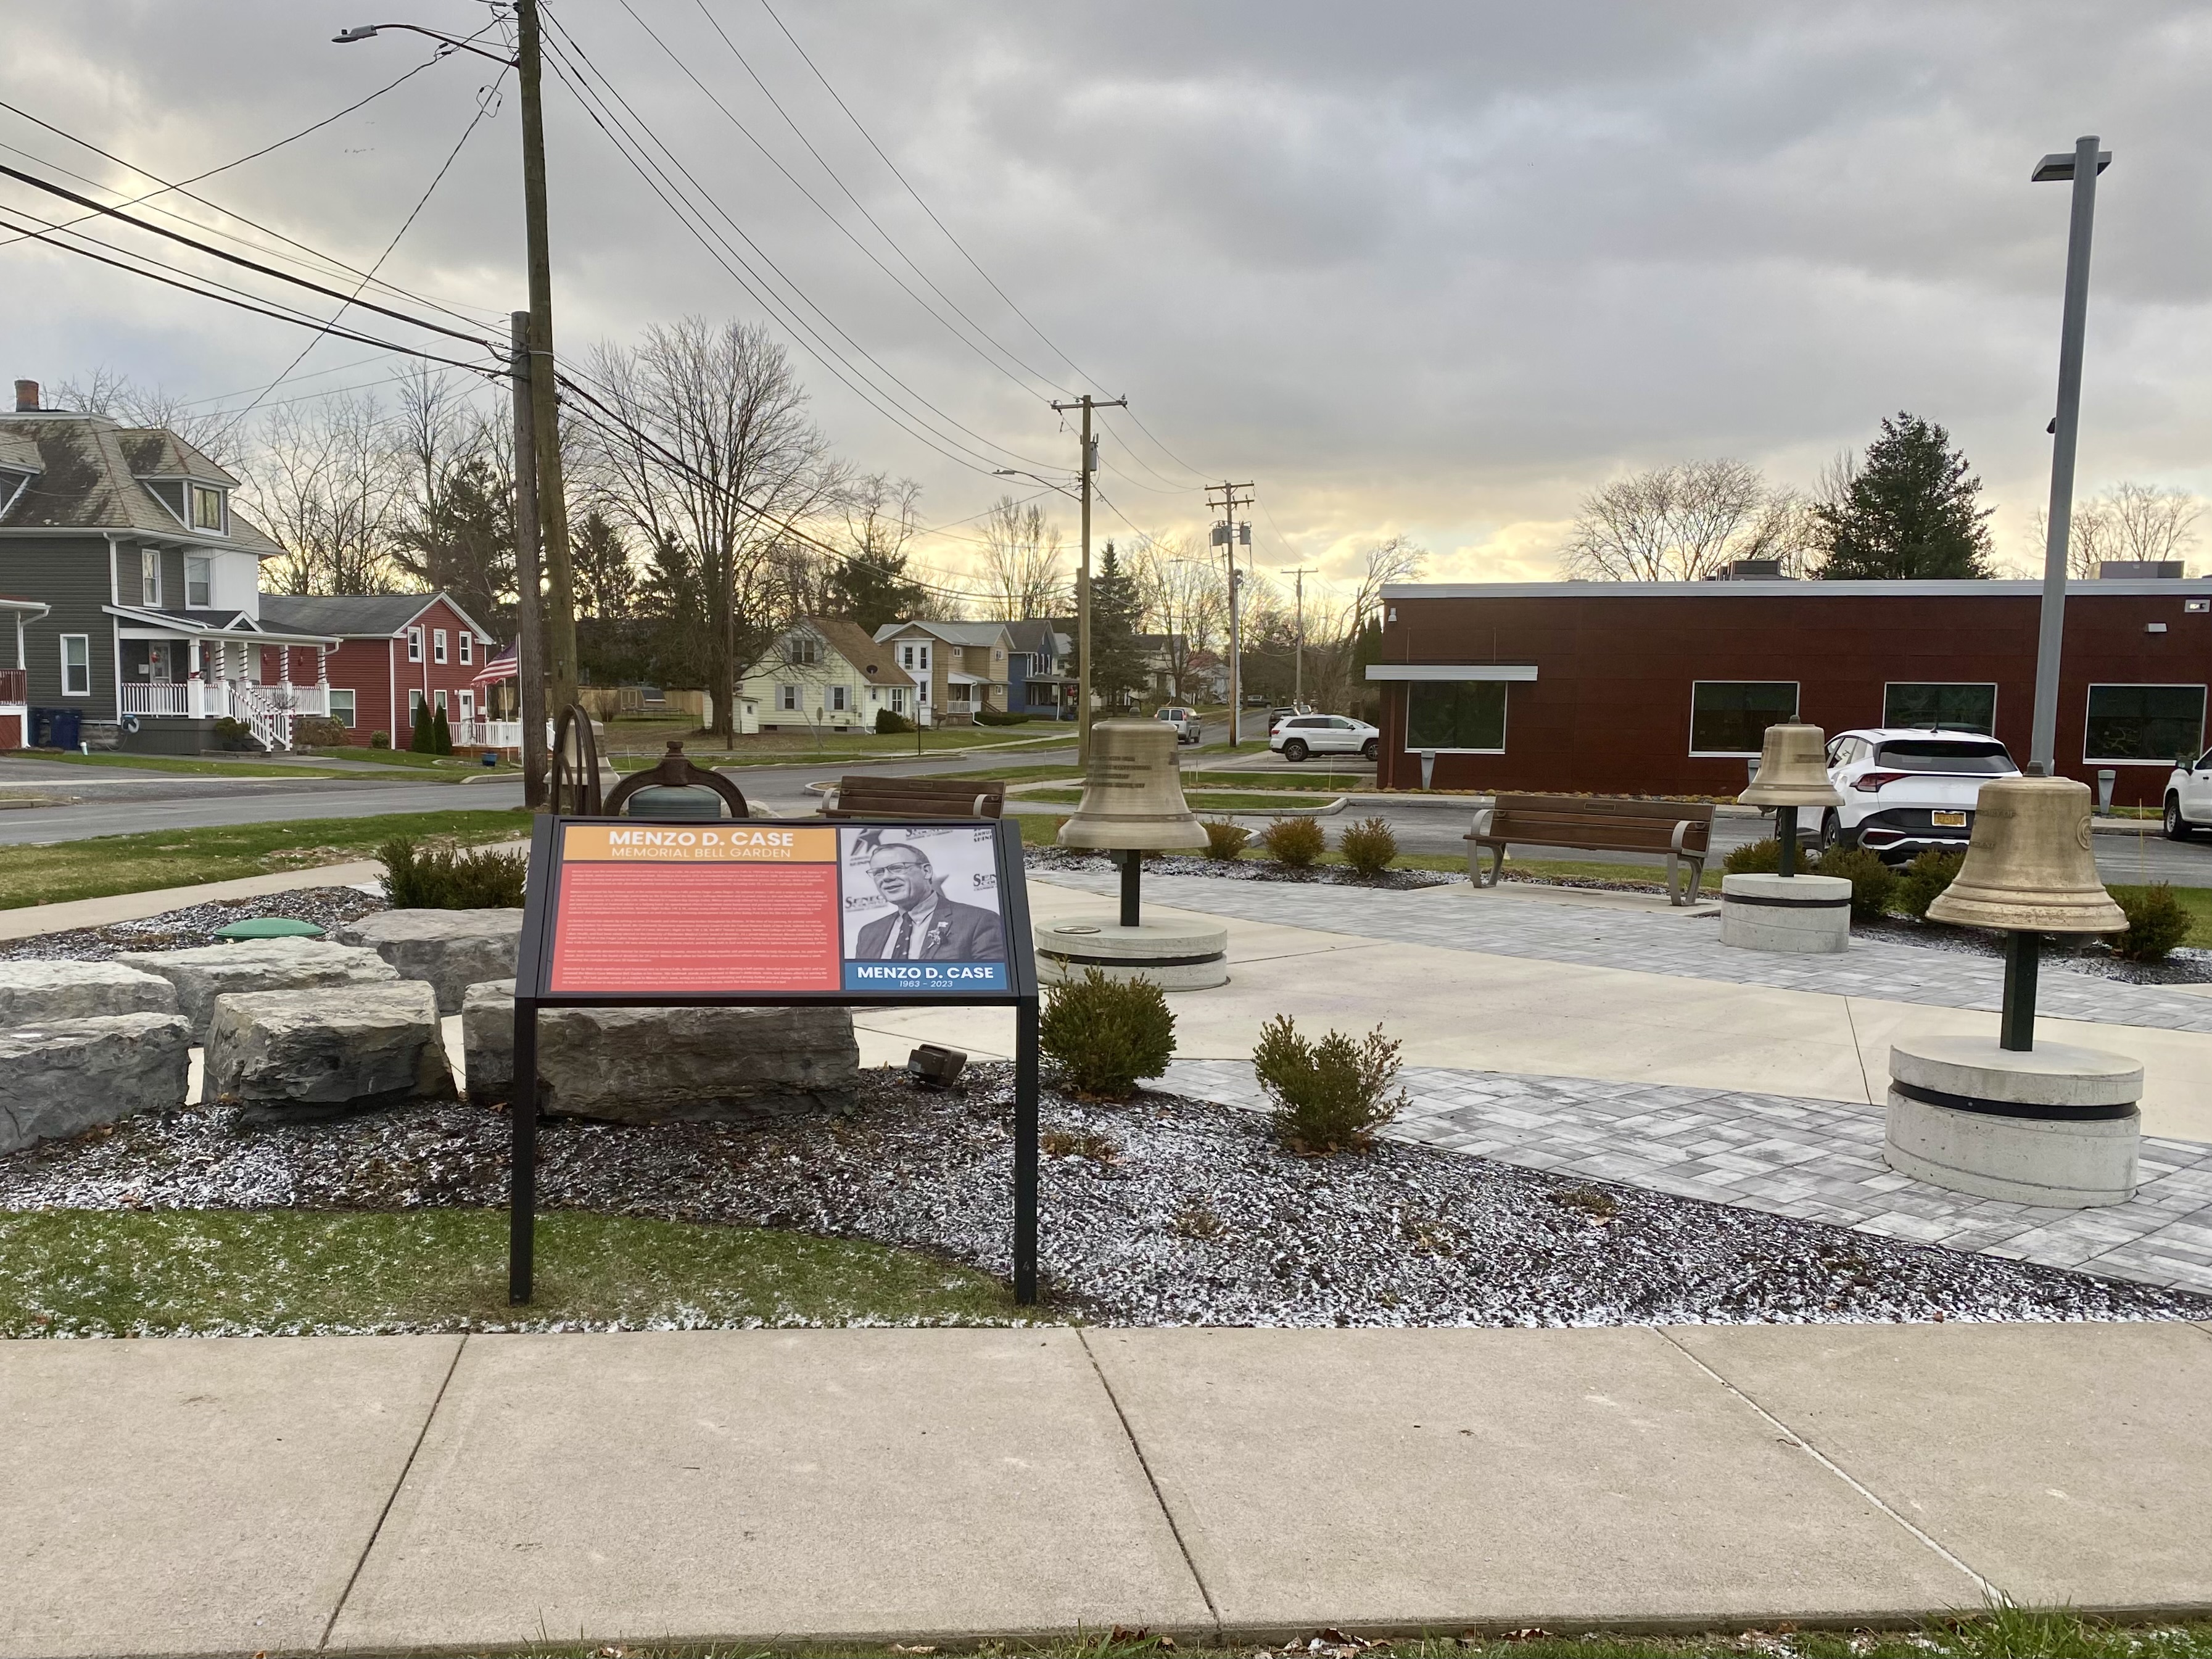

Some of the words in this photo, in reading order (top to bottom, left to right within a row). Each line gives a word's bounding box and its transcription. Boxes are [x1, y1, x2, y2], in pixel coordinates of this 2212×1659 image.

[609, 831, 696, 846] MENZO
[702, 832, 725, 846] D.
[731, 832, 794, 846] CASE
[611, 847, 690, 858] MEMORIAL
[695, 848, 725, 858] BELL
[730, 848, 791, 858] GARDEN
[857, 967, 922, 978] MENZO
[925, 967, 943, 978] D.
[947, 967, 994, 978] CASE
